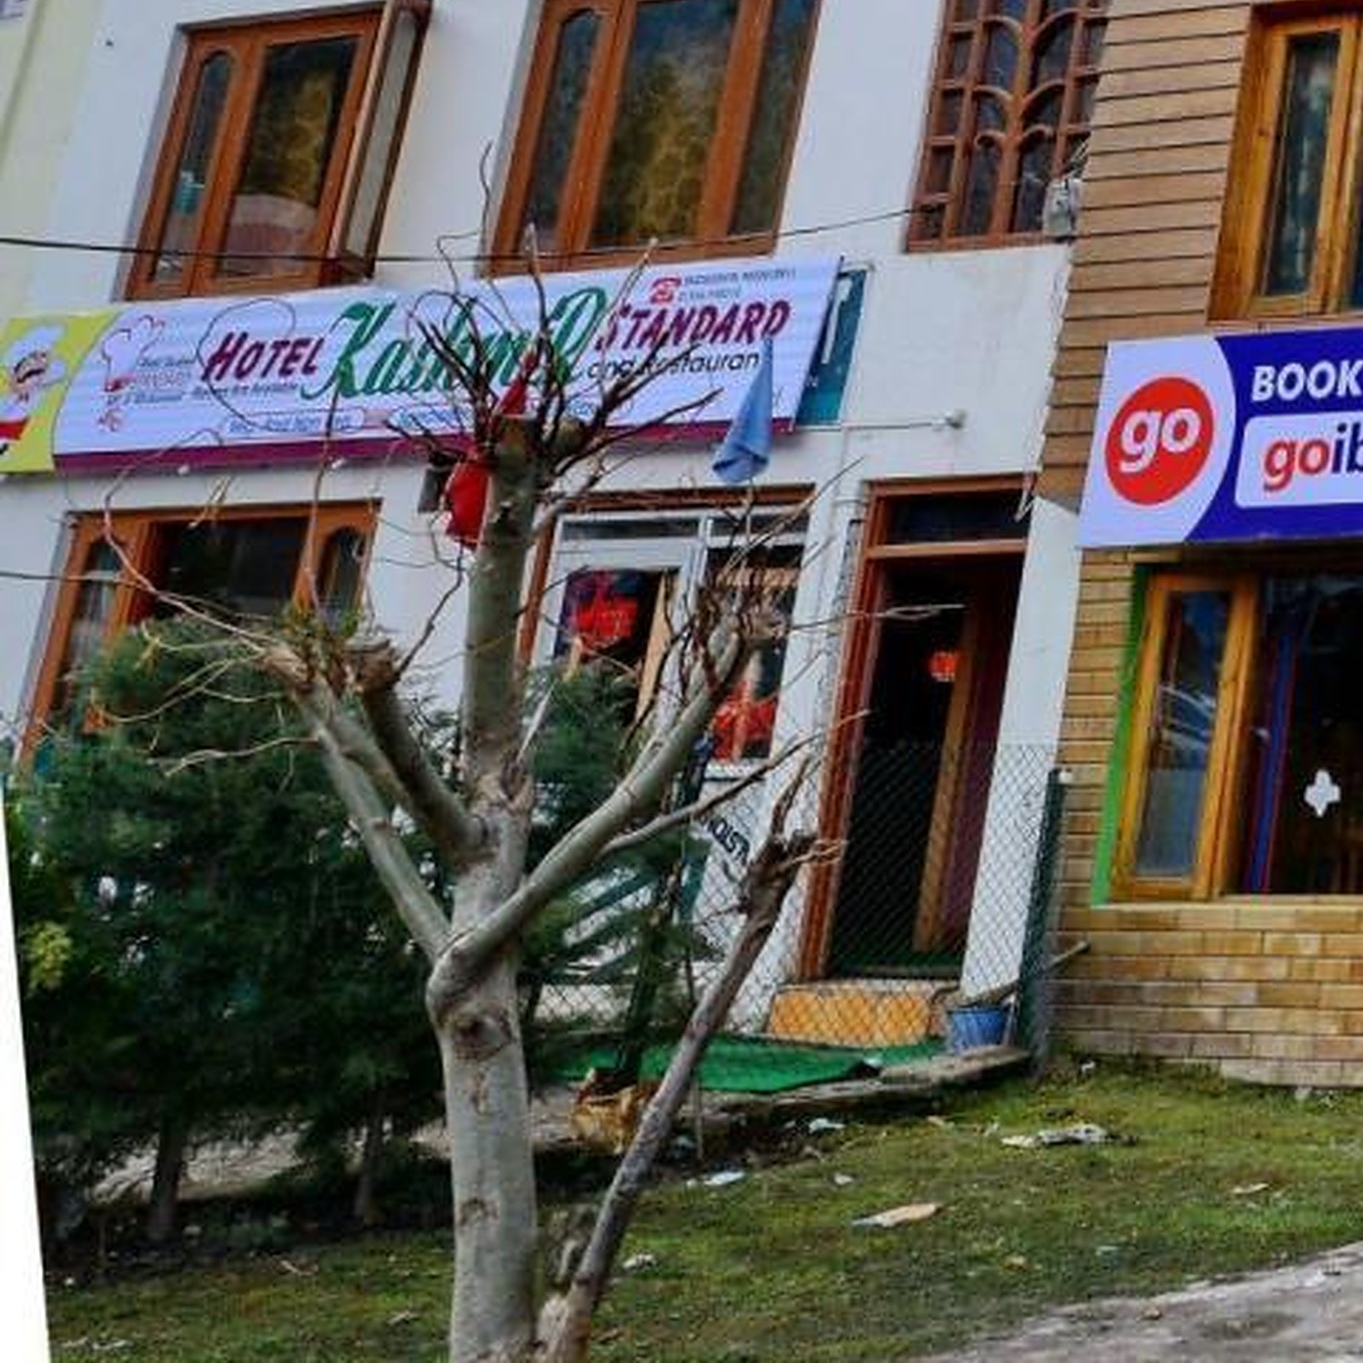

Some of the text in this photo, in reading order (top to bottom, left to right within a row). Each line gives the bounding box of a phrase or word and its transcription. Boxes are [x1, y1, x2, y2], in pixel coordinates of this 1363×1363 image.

[201, 331, 326, 381] HOTEL
[596, 300, 790, 351] STANDARD
[1251, 358, 1361, 403] BOOK
[1118, 407, 1201, 473] go
